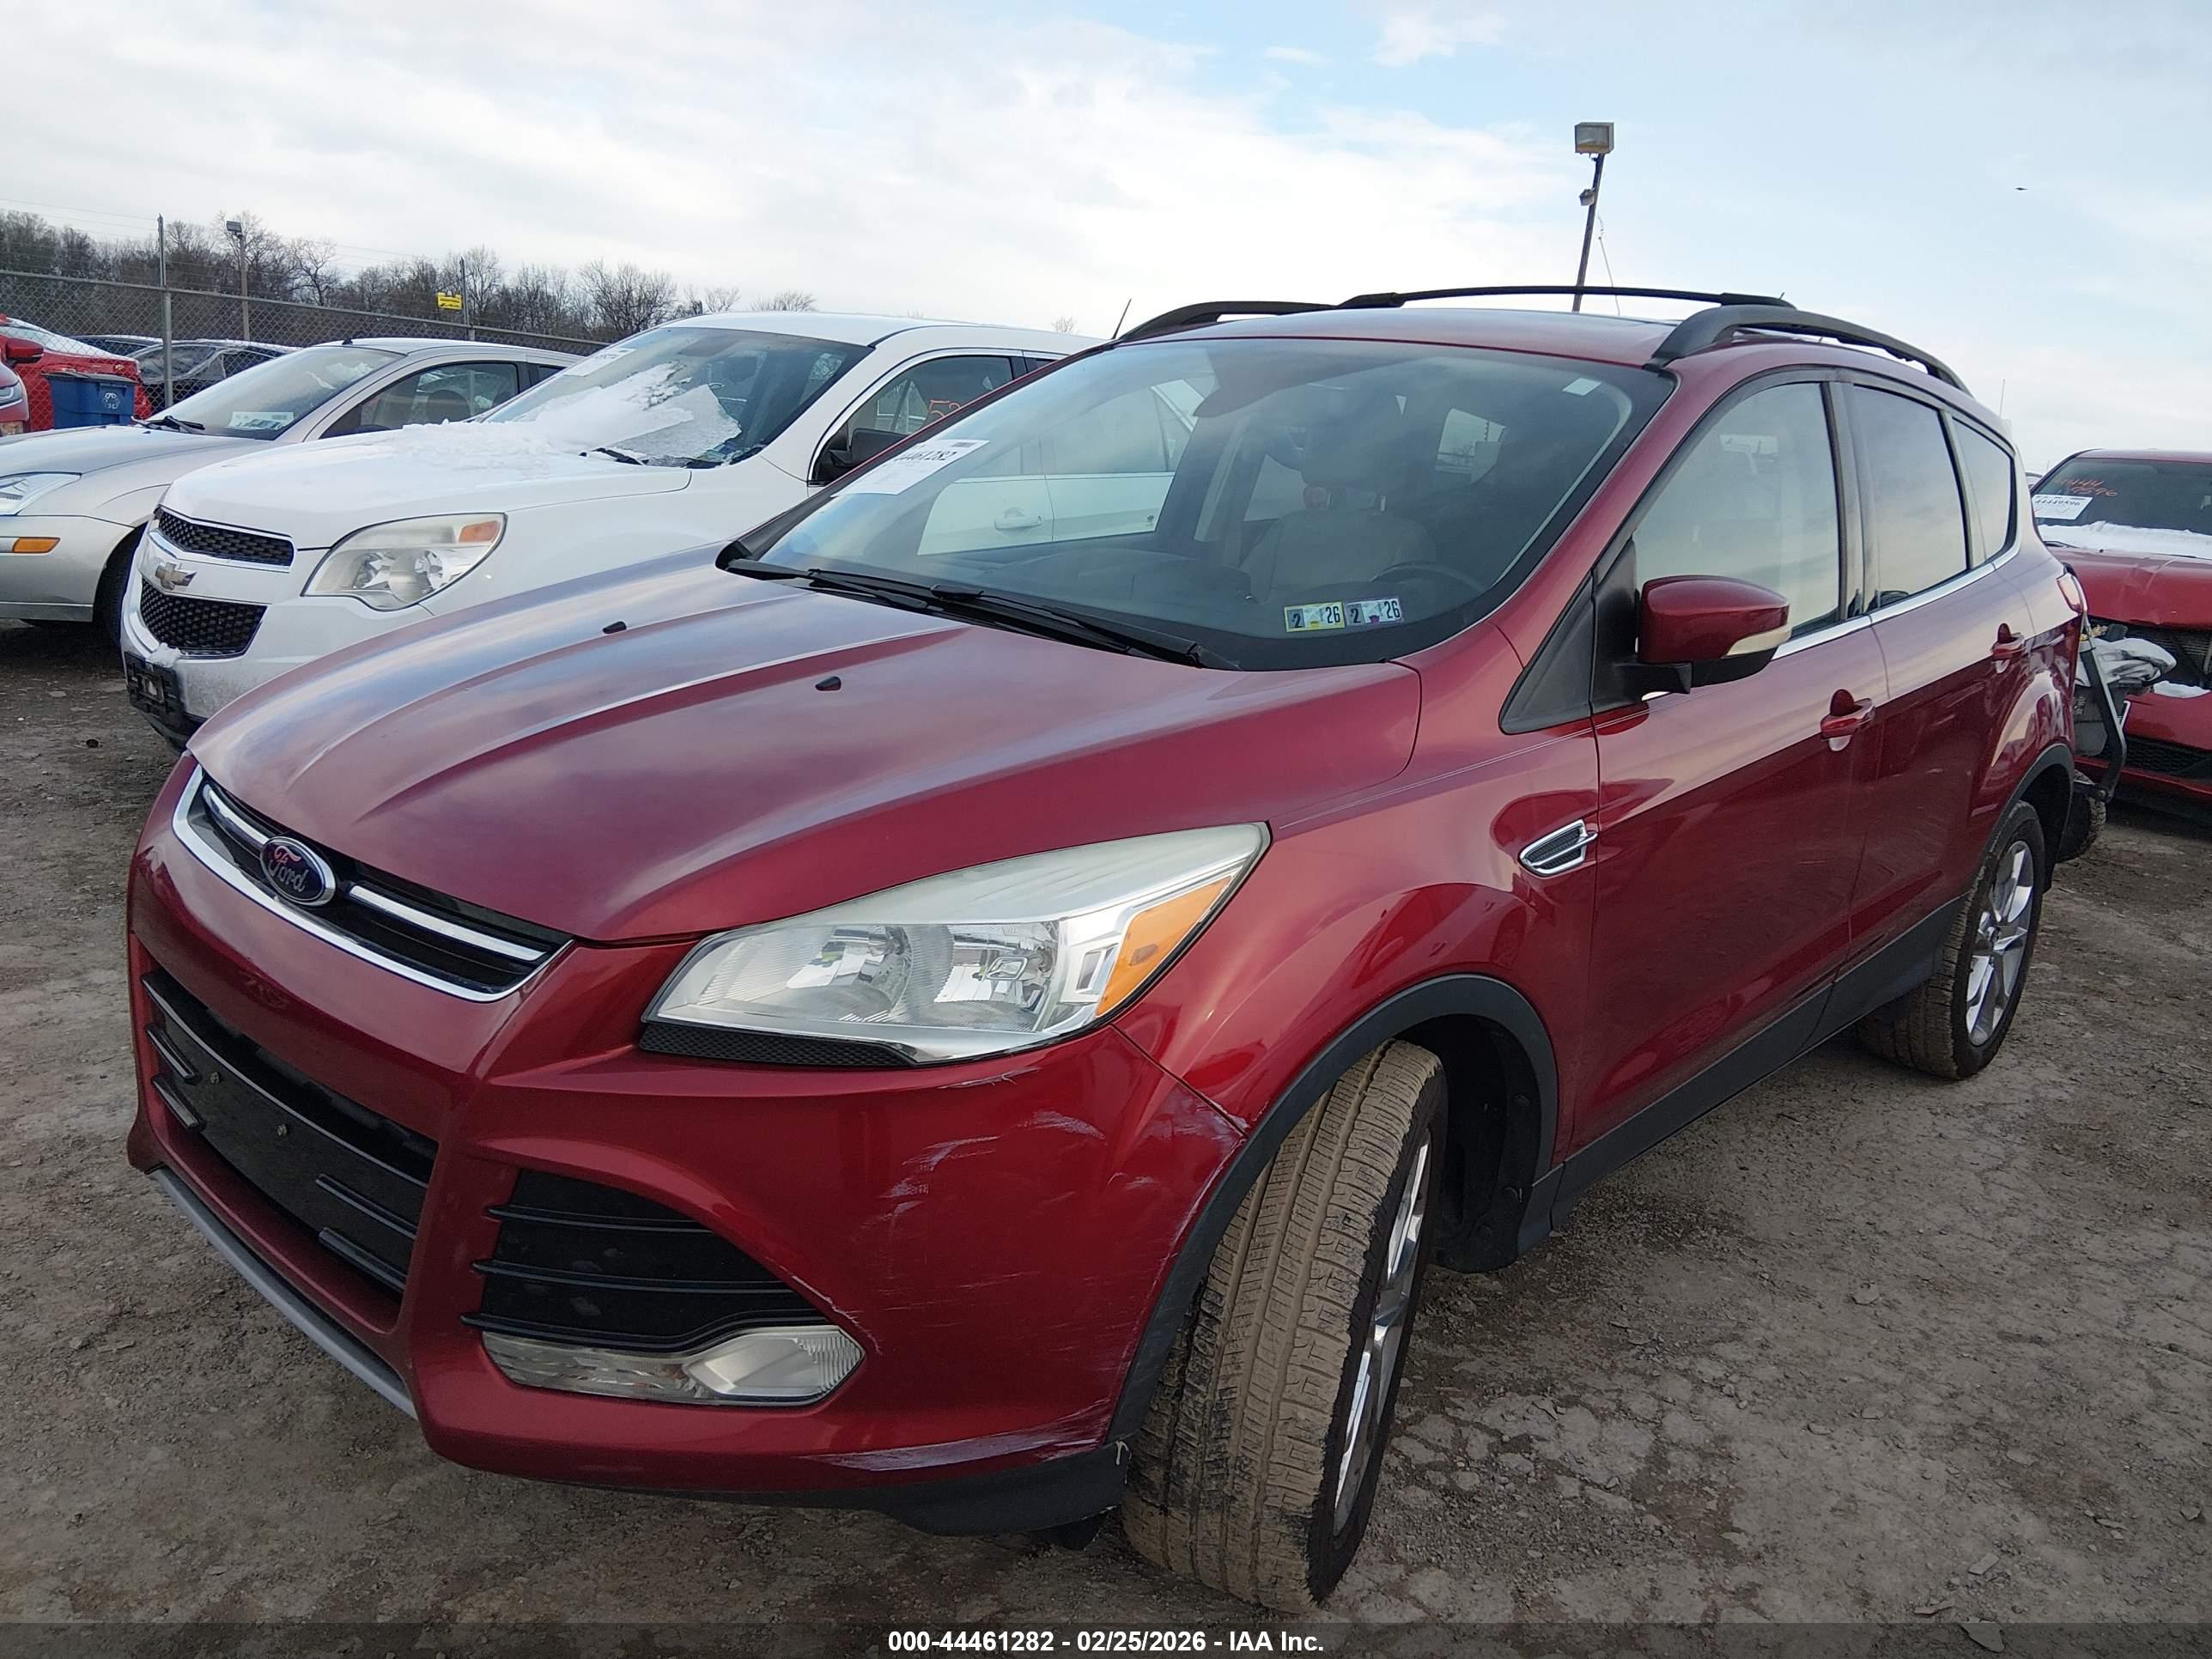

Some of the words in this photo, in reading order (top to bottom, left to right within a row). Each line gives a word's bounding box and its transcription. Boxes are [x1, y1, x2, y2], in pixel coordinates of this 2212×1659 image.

[1325, 605, 1341, 624] 26
[1384, 600, 1401, 619] 26
[268, 845, 310, 892] Ford
